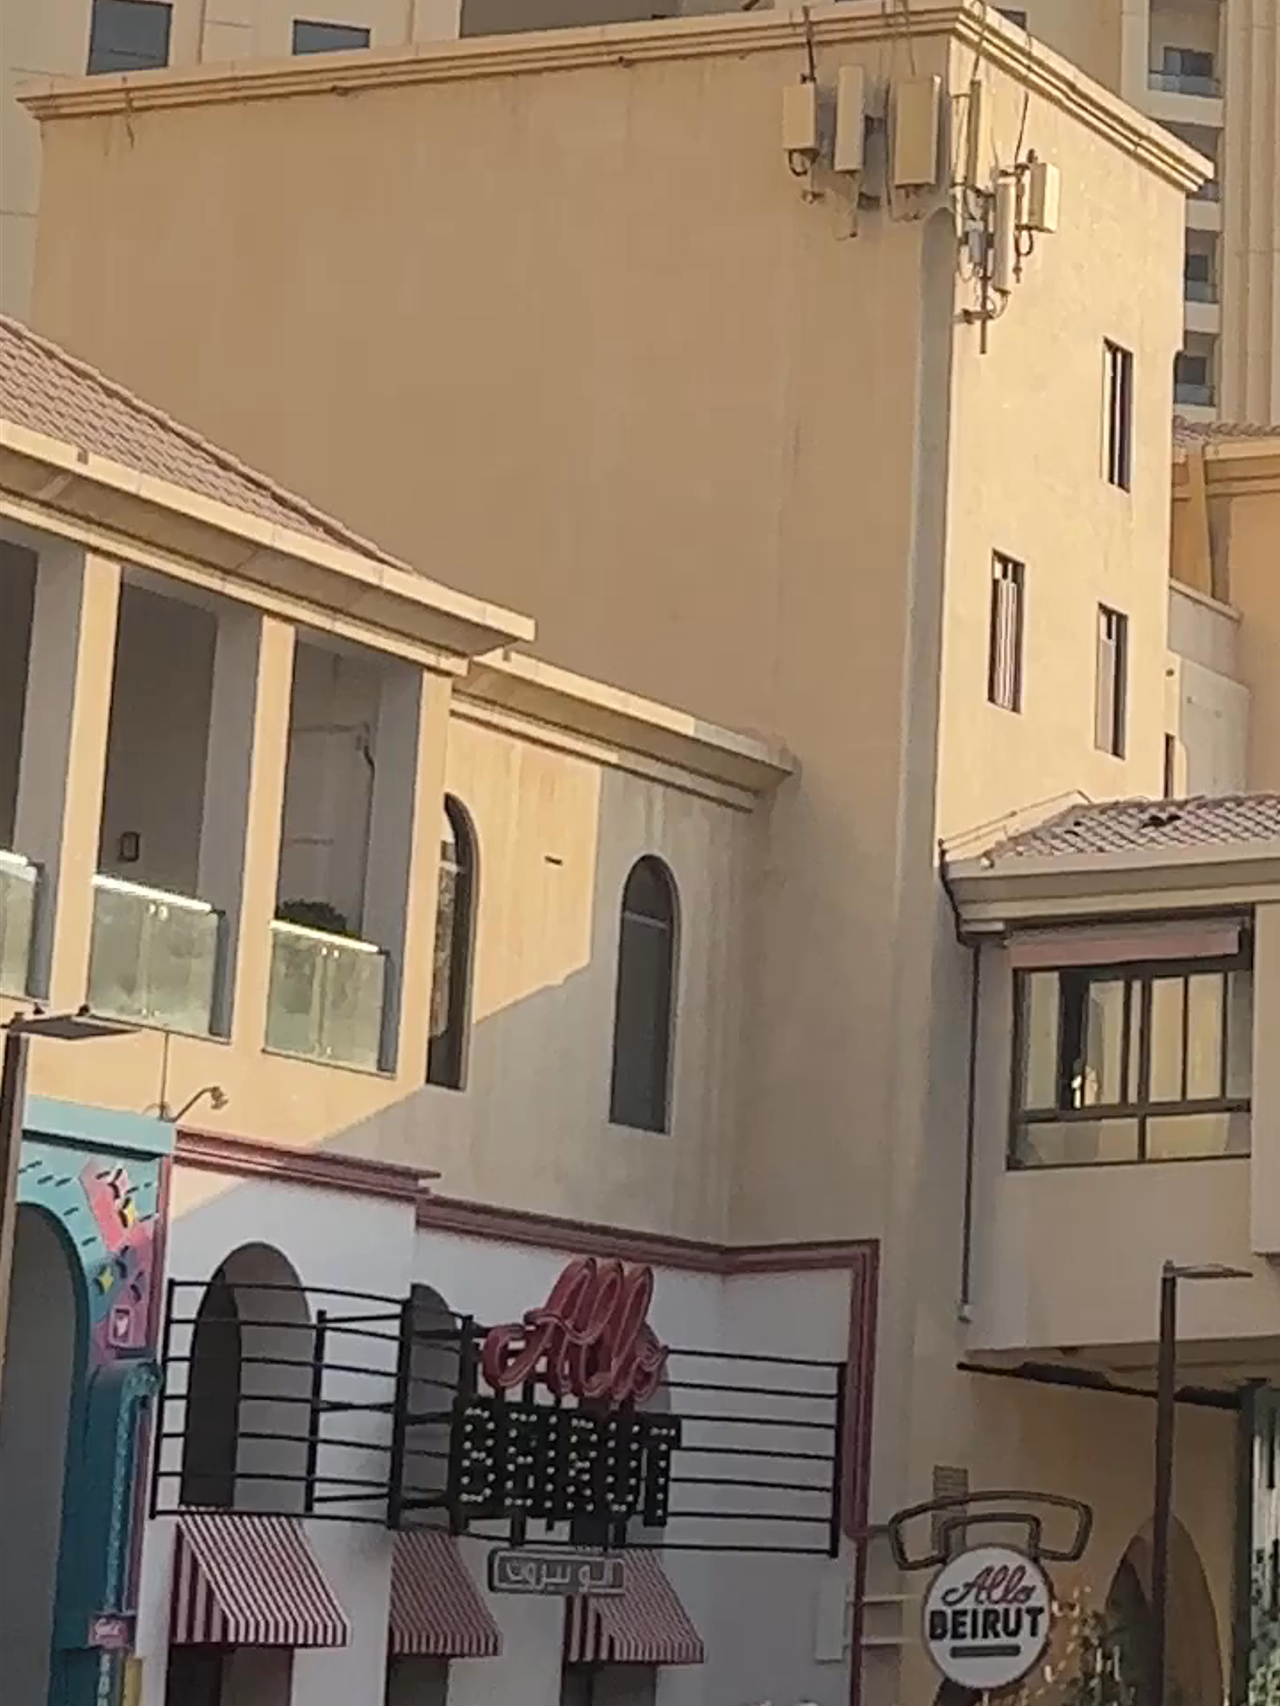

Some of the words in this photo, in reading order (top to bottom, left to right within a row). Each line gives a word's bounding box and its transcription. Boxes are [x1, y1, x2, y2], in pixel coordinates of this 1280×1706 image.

[482, 1256, 669, 1402] Allo
[455, 1398, 682, 1528] BEIRUT
[928, 1605, 1045, 1641] BEIRUT
[941, 1564, 1037, 1606] Allo
